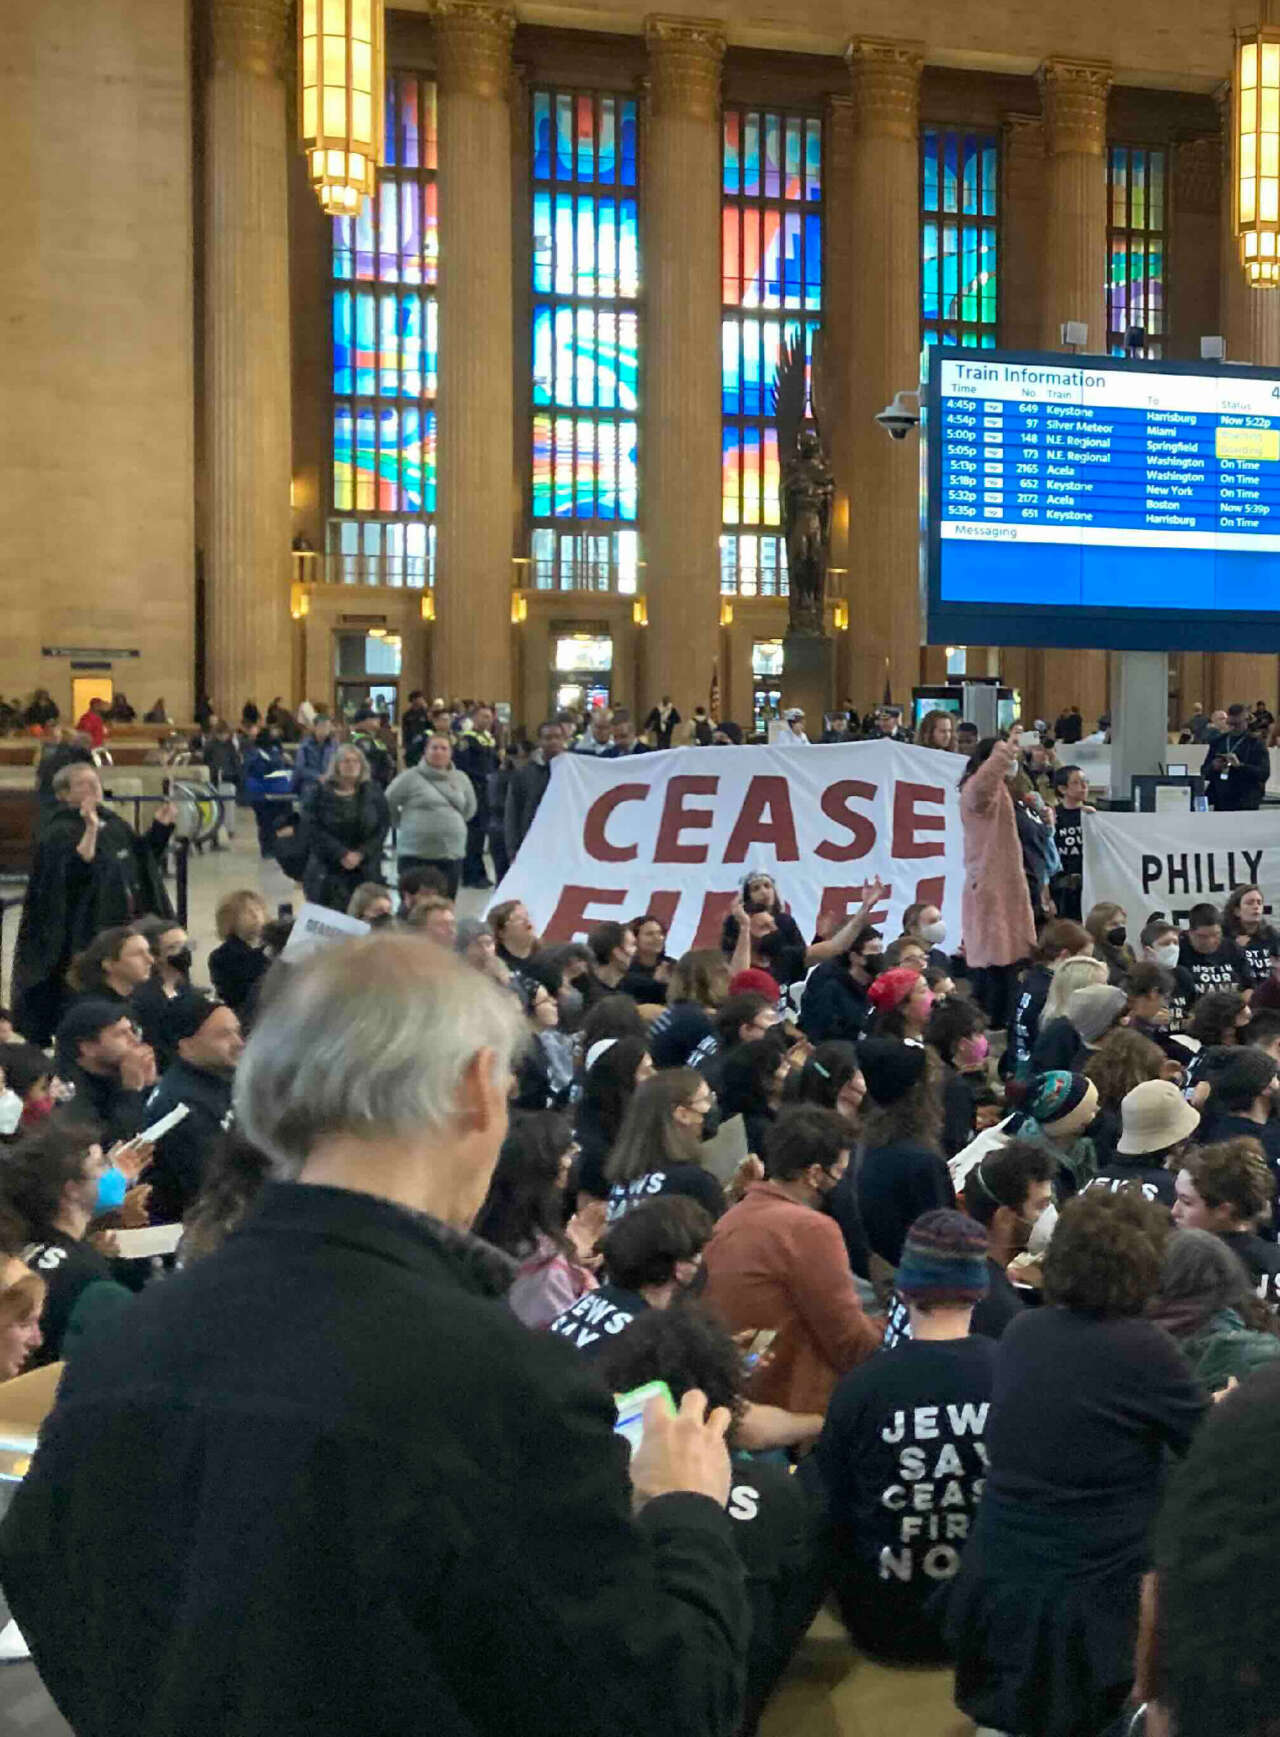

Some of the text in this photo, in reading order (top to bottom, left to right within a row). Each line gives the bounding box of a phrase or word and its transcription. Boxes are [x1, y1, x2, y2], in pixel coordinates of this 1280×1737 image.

[955, 364, 1107, 388] Train Information
[951, 383, 977, 395] Time
[1021, 388, 1037, 398] No
[1047, 390, 1072, 400] Train
[1148, 396, 1159, 405] To
[946, 399, 977, 413] 4:45p
[1018, 404, 1039, 414] 649
[1046, 405, 1095, 418] Keystone
[1146, 412, 1197, 425] Harrisburg
[1220, 416, 1244, 426] Now
[946, 414, 977, 428] 4:54p
[1026, 419, 1039, 429] 97
[1046, 420, 1075, 432] Silver
[1076, 422, 1114, 434] Meteor
[1147, 427, 1177, 438] Miami
[946, 429, 977, 442] 5:00p
[1021, 433, 1039, 444] 148
[1067, 436, 1111, 450] Regional
[1146, 441, 1198, 454] Springfield
[948, 445, 977, 458] 5:05p
[1067, 451, 1111, 464] Regional
[1146, 456, 1205, 469] Washington
[1220, 459, 1235, 469] On
[1236, 460, 1260, 470] Time
[1046, 465, 1076, 477] Acela
[1146, 470, 1205, 483] Washington
[1220, 474, 1235, 483] On
[1236, 475, 1260, 485] Time
[1019, 479, 1039, 489] 652
[1046, 480, 1094, 492] Keystone
[1146, 485, 1170, 496] New
[1171, 486, 1194, 496] York
[1220, 488, 1235, 498] On
[1236, 489, 1260, 499] Time
[1046, 495, 1075, 506] Acela
[1146, 500, 1180, 510] Boston
[1220, 503, 1243, 513] Now
[1021, 509, 1039, 519] 651
[1046, 510, 1094, 522] Keystone
[1146, 514, 1197, 528] Harrisburg
[1220, 517, 1235, 527] On
[1236, 518, 1260, 528] Time
[955, 525, 1018, 539] Messaging
[583, 774, 946, 865] CEASE
[1142, 849, 1264, 895] PHILLY
[1192, 963, 1233, 974] NOT IN
[1200, 972, 1232, 983] OUR
[881, 1402, 991, 1443] JEW
[901, 1512, 970, 1544] FIR
[878, 1543, 961, 1583] NO
